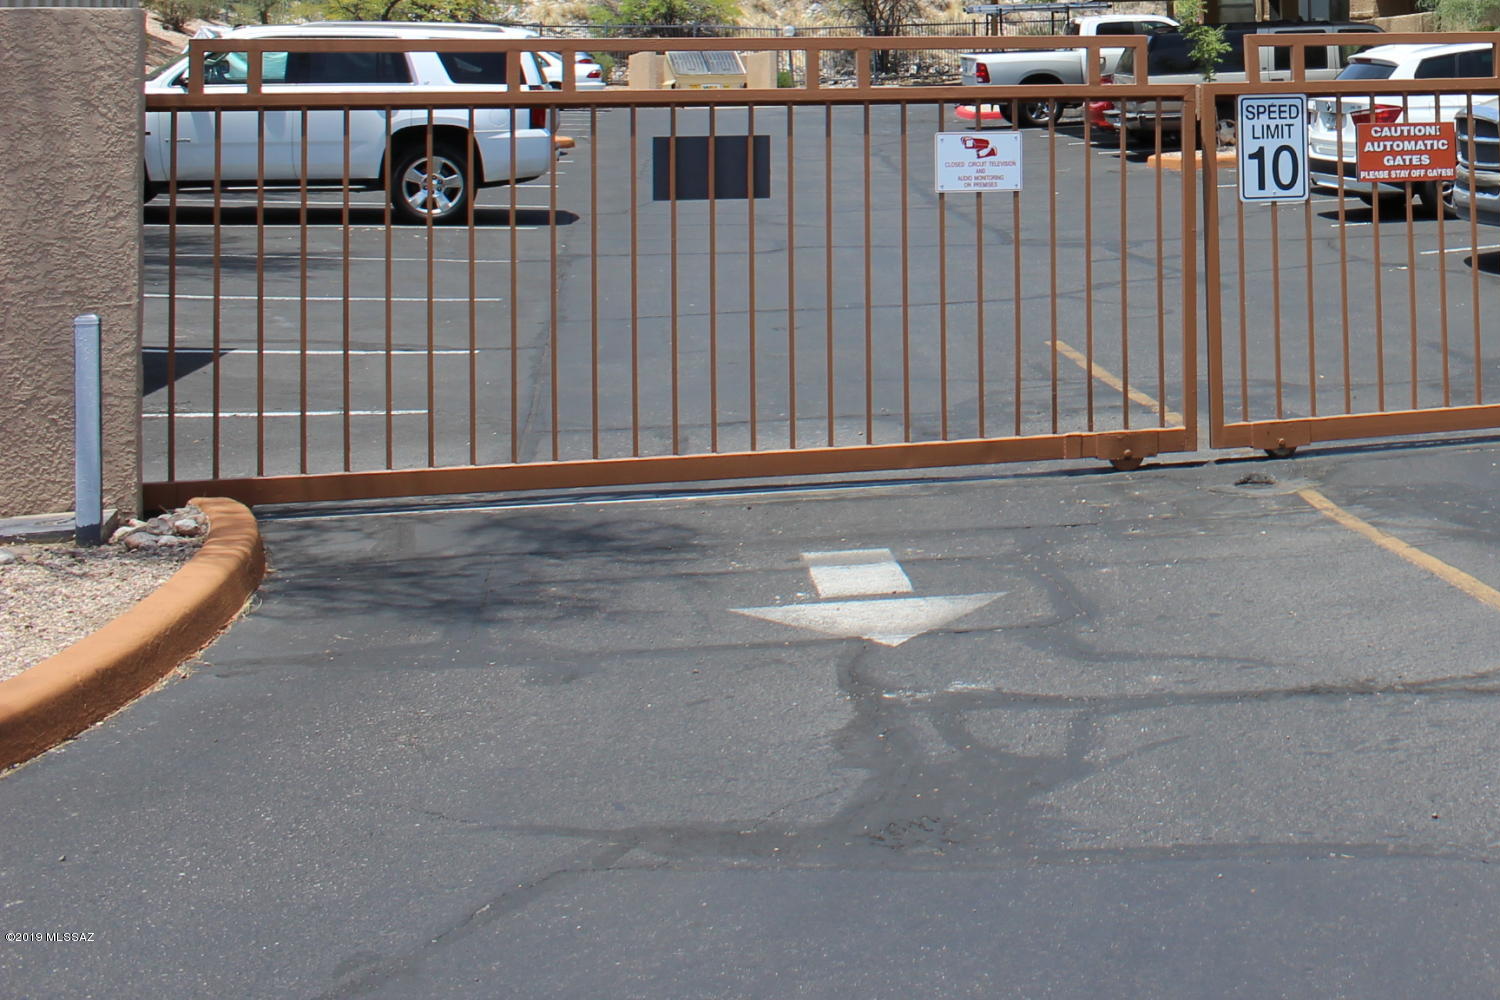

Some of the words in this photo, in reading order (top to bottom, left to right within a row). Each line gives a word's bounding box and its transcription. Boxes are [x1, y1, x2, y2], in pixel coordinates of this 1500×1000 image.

[1245, 104, 1300, 120] SPEED
[1252, 123, 1294, 140] LIMIT
[1371, 126, 1440, 137] CAUTION!
[1364, 140, 1448, 152] AUTOMATIC
[1384, 155, 1430, 166] GATES
[1248, 145, 1299, 191] 10
[1360, 170, 1389, 179] PLEASE
[1391, 170, 1412, 178] STAY
[1413, 169, 1426, 177] OFF
[1427, 168, 1454, 177] GATES!
